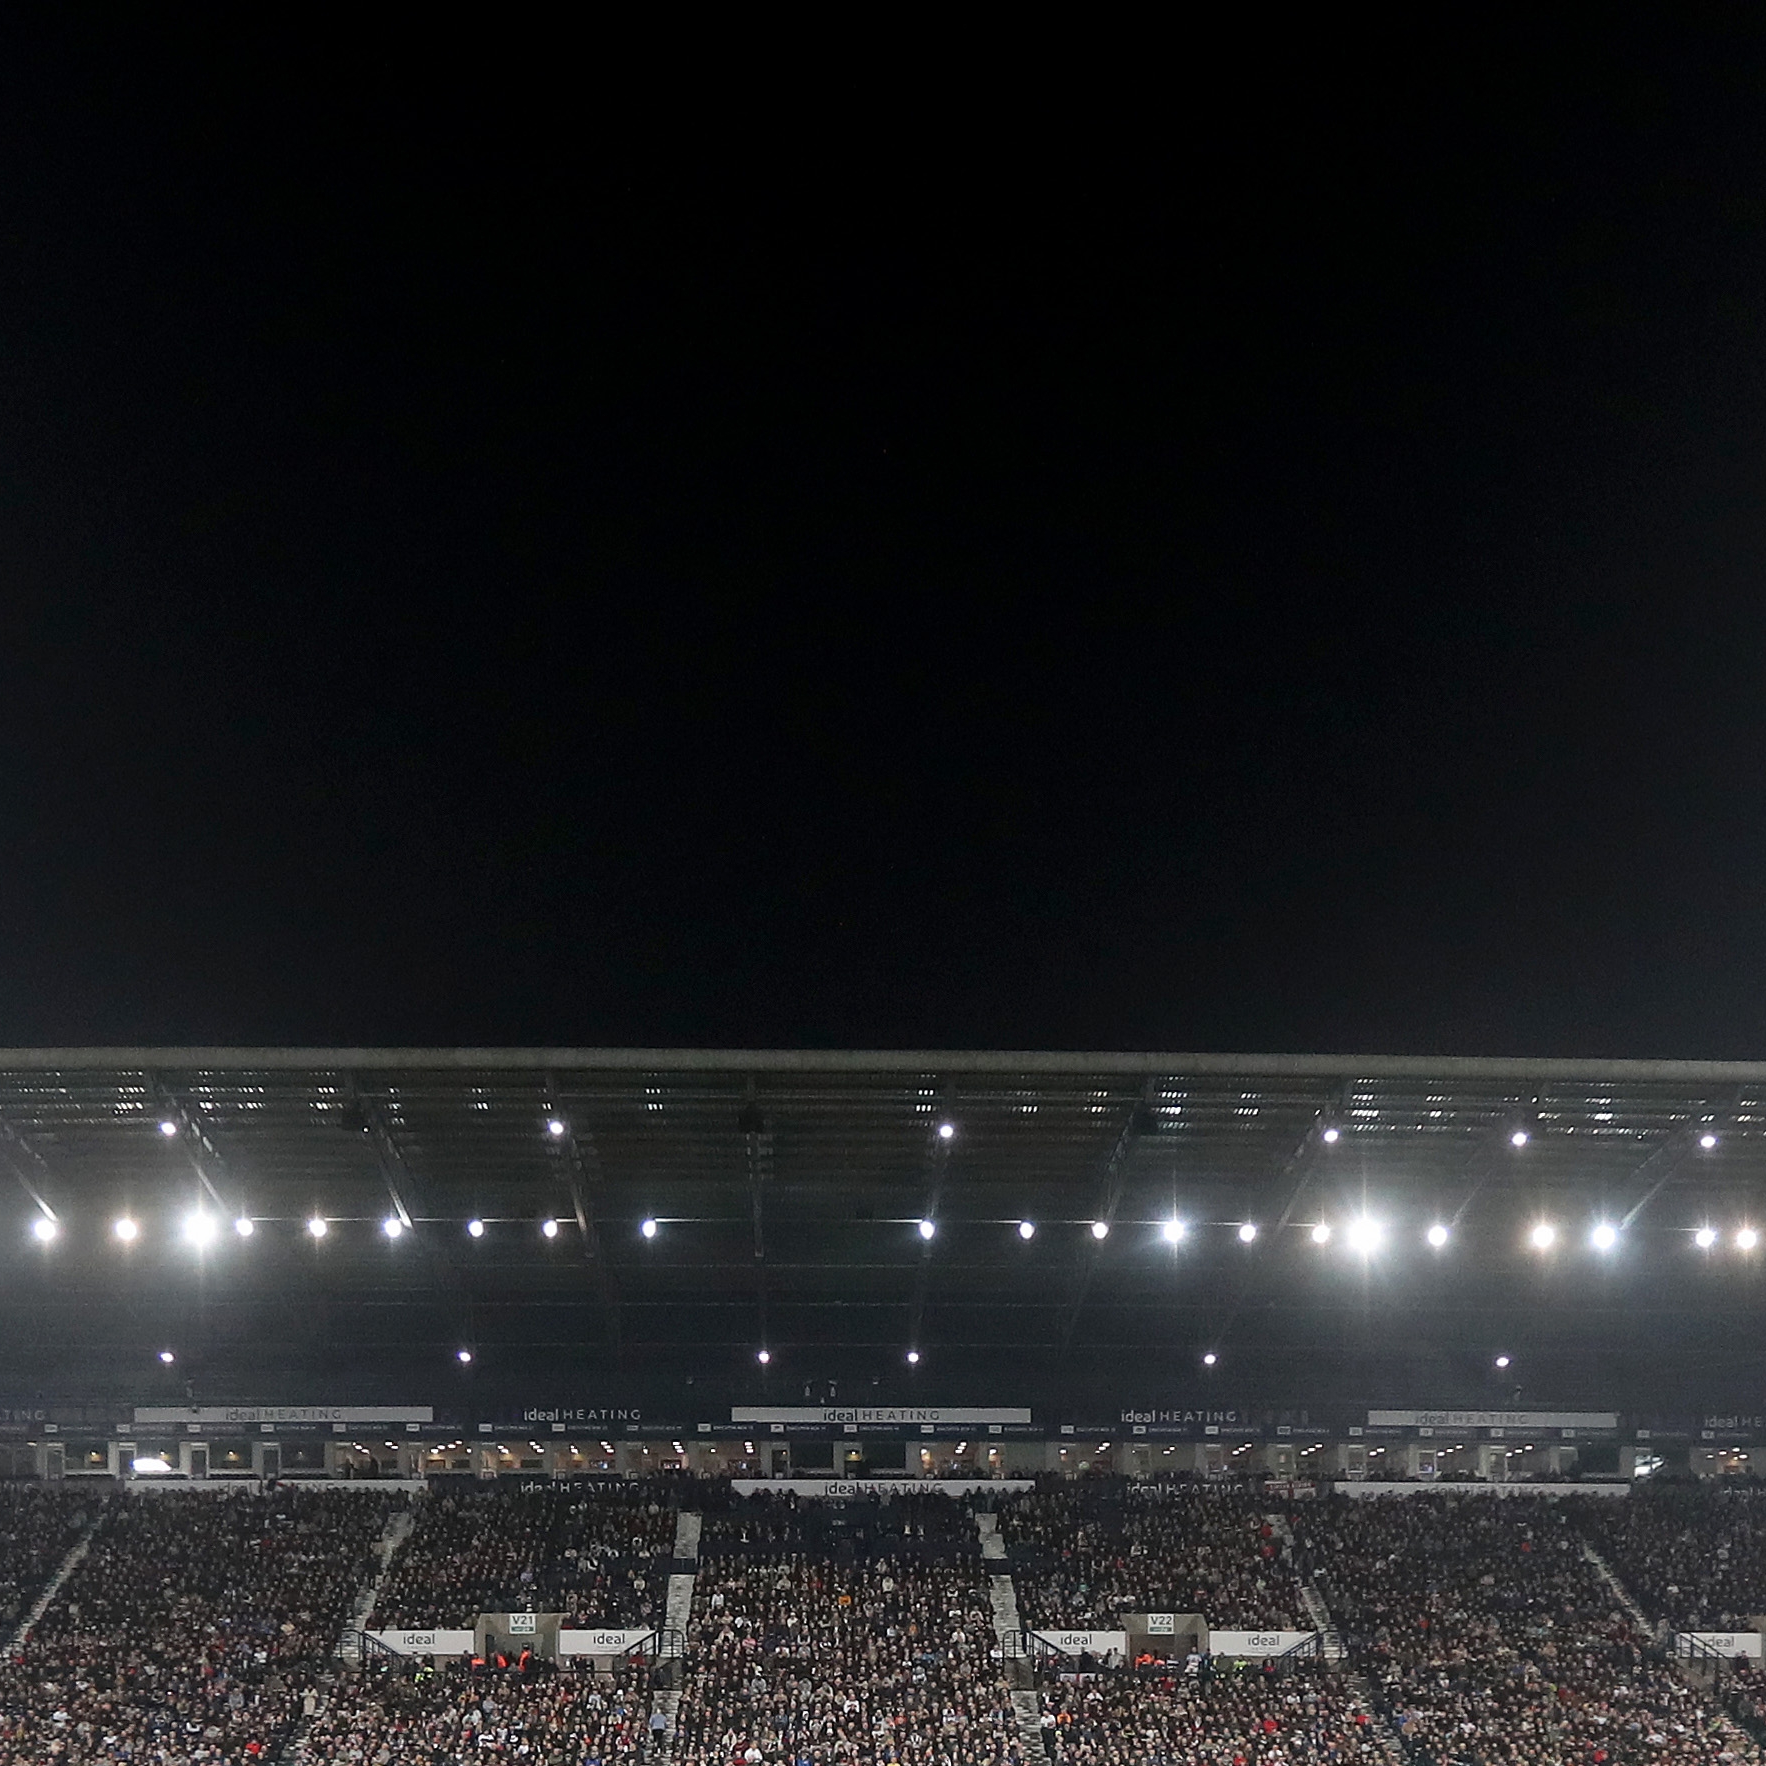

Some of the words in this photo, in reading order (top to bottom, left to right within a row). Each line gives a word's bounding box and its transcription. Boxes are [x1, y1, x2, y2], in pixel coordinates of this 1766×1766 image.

[225, 1409, 260, 1421] ideal
[264, 1409, 342, 1420] HEATING
[524, 1408, 558, 1421] ideal
[563, 1409, 641, 1420] HEATING
[823, 1409, 858, 1422] ideal
[862, 1410, 940, 1421] HEATING
[1121, 1409, 1156, 1423] ideal
[1159, 1410, 1237, 1422] HEATING
[512, 1615, 533, 1625] V21
[1150, 1615, 1172, 1626] V22
[403, 1633, 435, 1645] ideal
[593, 1633, 625, 1645] ideal
[1060, 1633, 1092, 1645] ideal
[1248, 1634, 1280, 1646] ideal
[1708, 1636, 1735, 1648] deal
